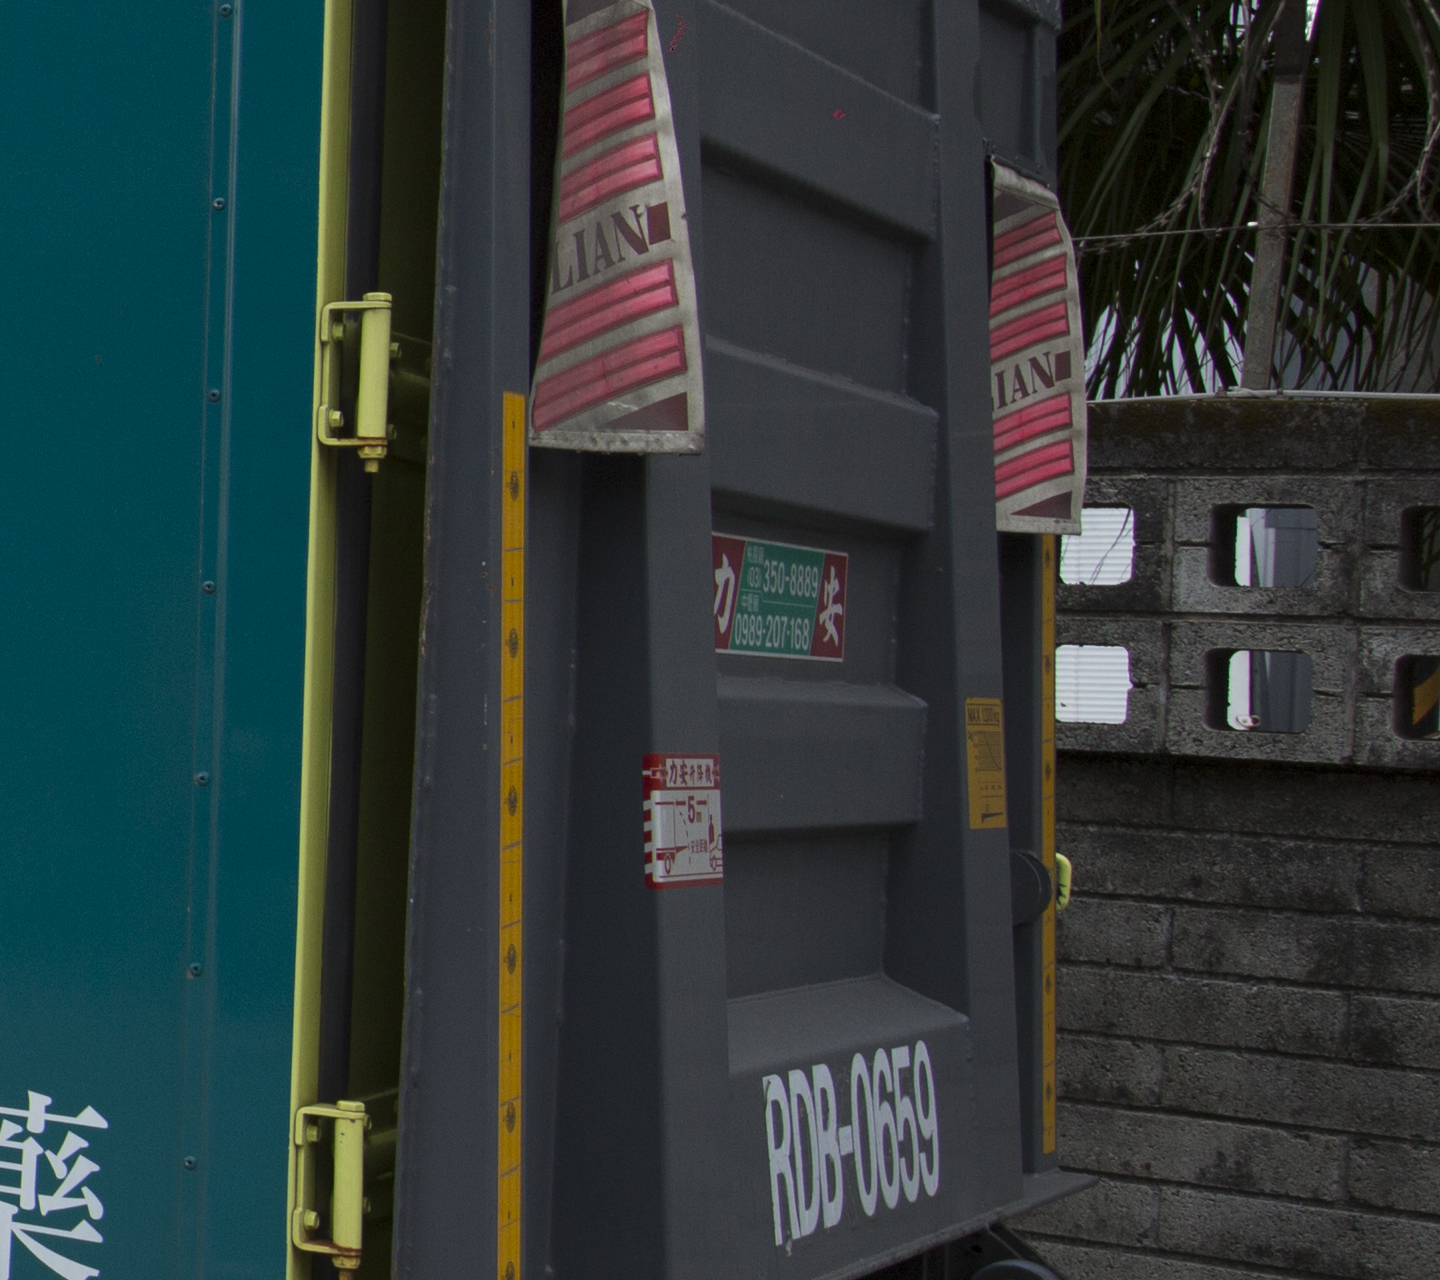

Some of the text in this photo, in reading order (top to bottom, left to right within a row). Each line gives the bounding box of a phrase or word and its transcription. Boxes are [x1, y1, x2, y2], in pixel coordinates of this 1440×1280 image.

[991, 351, 1055, 411] IAN
[713, 552, 735, 634] 力
[763, 559, 818, 598] 350-8889
[819, 565, 843, 647] 安
[762, 1039, 940, 1247] RDB-0659
